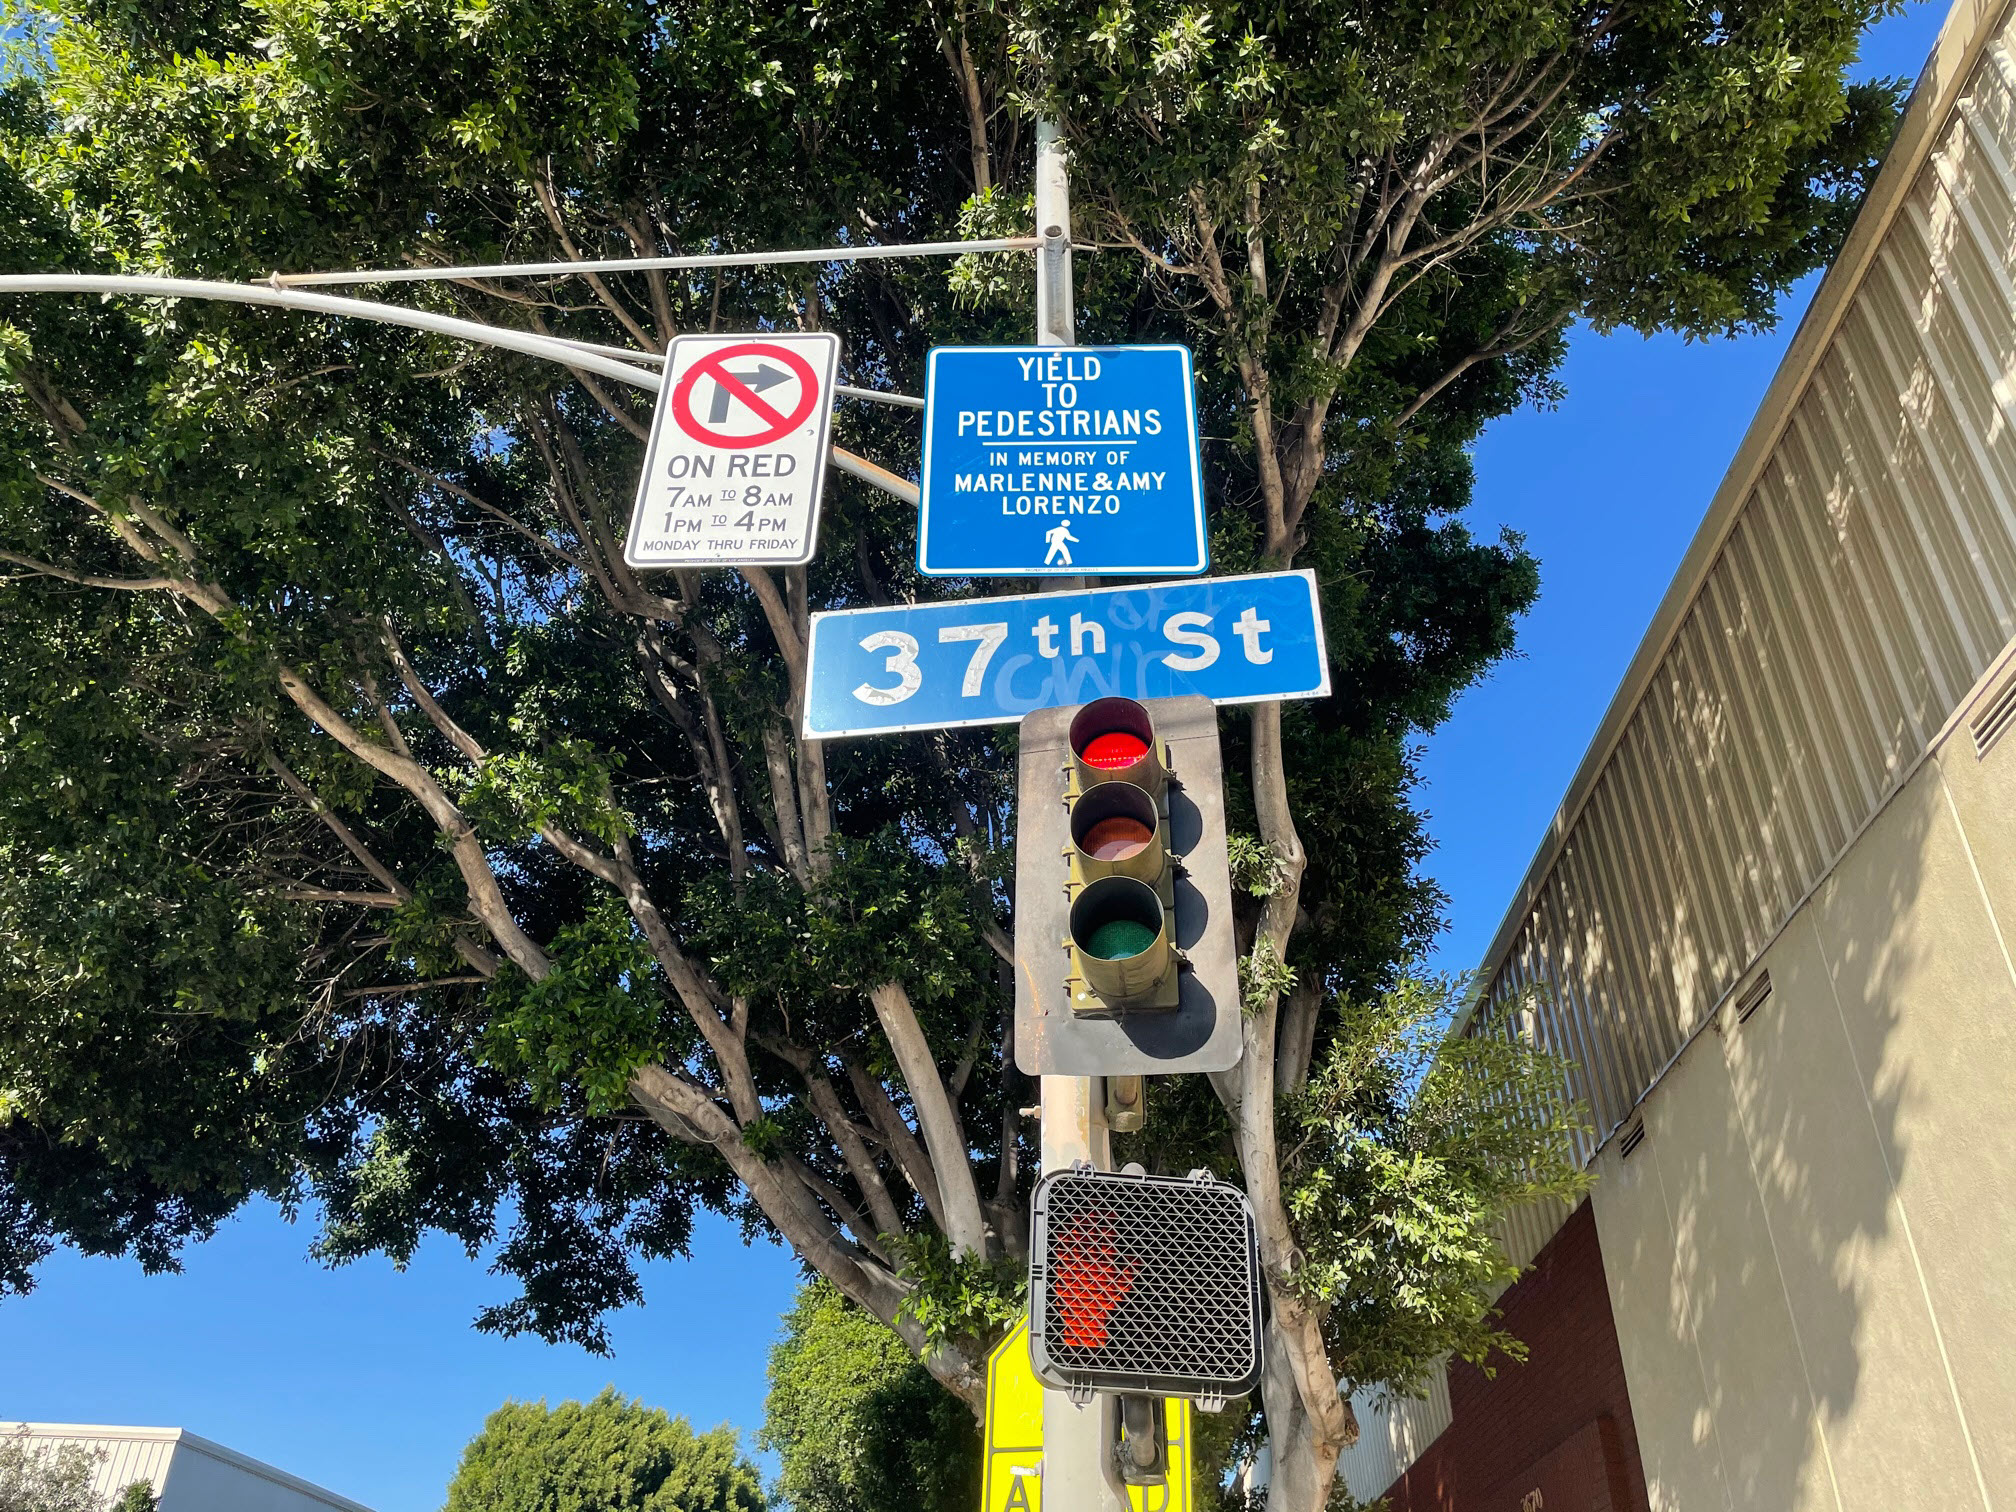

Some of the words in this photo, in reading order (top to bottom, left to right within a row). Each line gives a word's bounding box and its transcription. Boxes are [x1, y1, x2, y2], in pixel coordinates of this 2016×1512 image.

[1018, 356, 1100, 380] YIELD
[1042, 383, 1076, 408] TO
[959, 410, 1161, 436] PEDESTRIANS
[668, 455, 715, 478] ON
[727, 454, 796, 477] RED
[990, 453, 1007, 465] IN
[1019, 452, 1096, 465] MEMORY
[1107, 451, 1129, 465] OF
[721, 490, 736, 501] TO
[1003, 495, 1120, 514] LORENZO
[711, 515, 726, 526] TO
[644, 541, 700, 550] MONDAY
[708, 540, 743, 549] THRU
[750, 539, 798, 549] FRIDAY
[851, 612, 1106, 706] 37th
[1161, 606, 1273, 671] St
